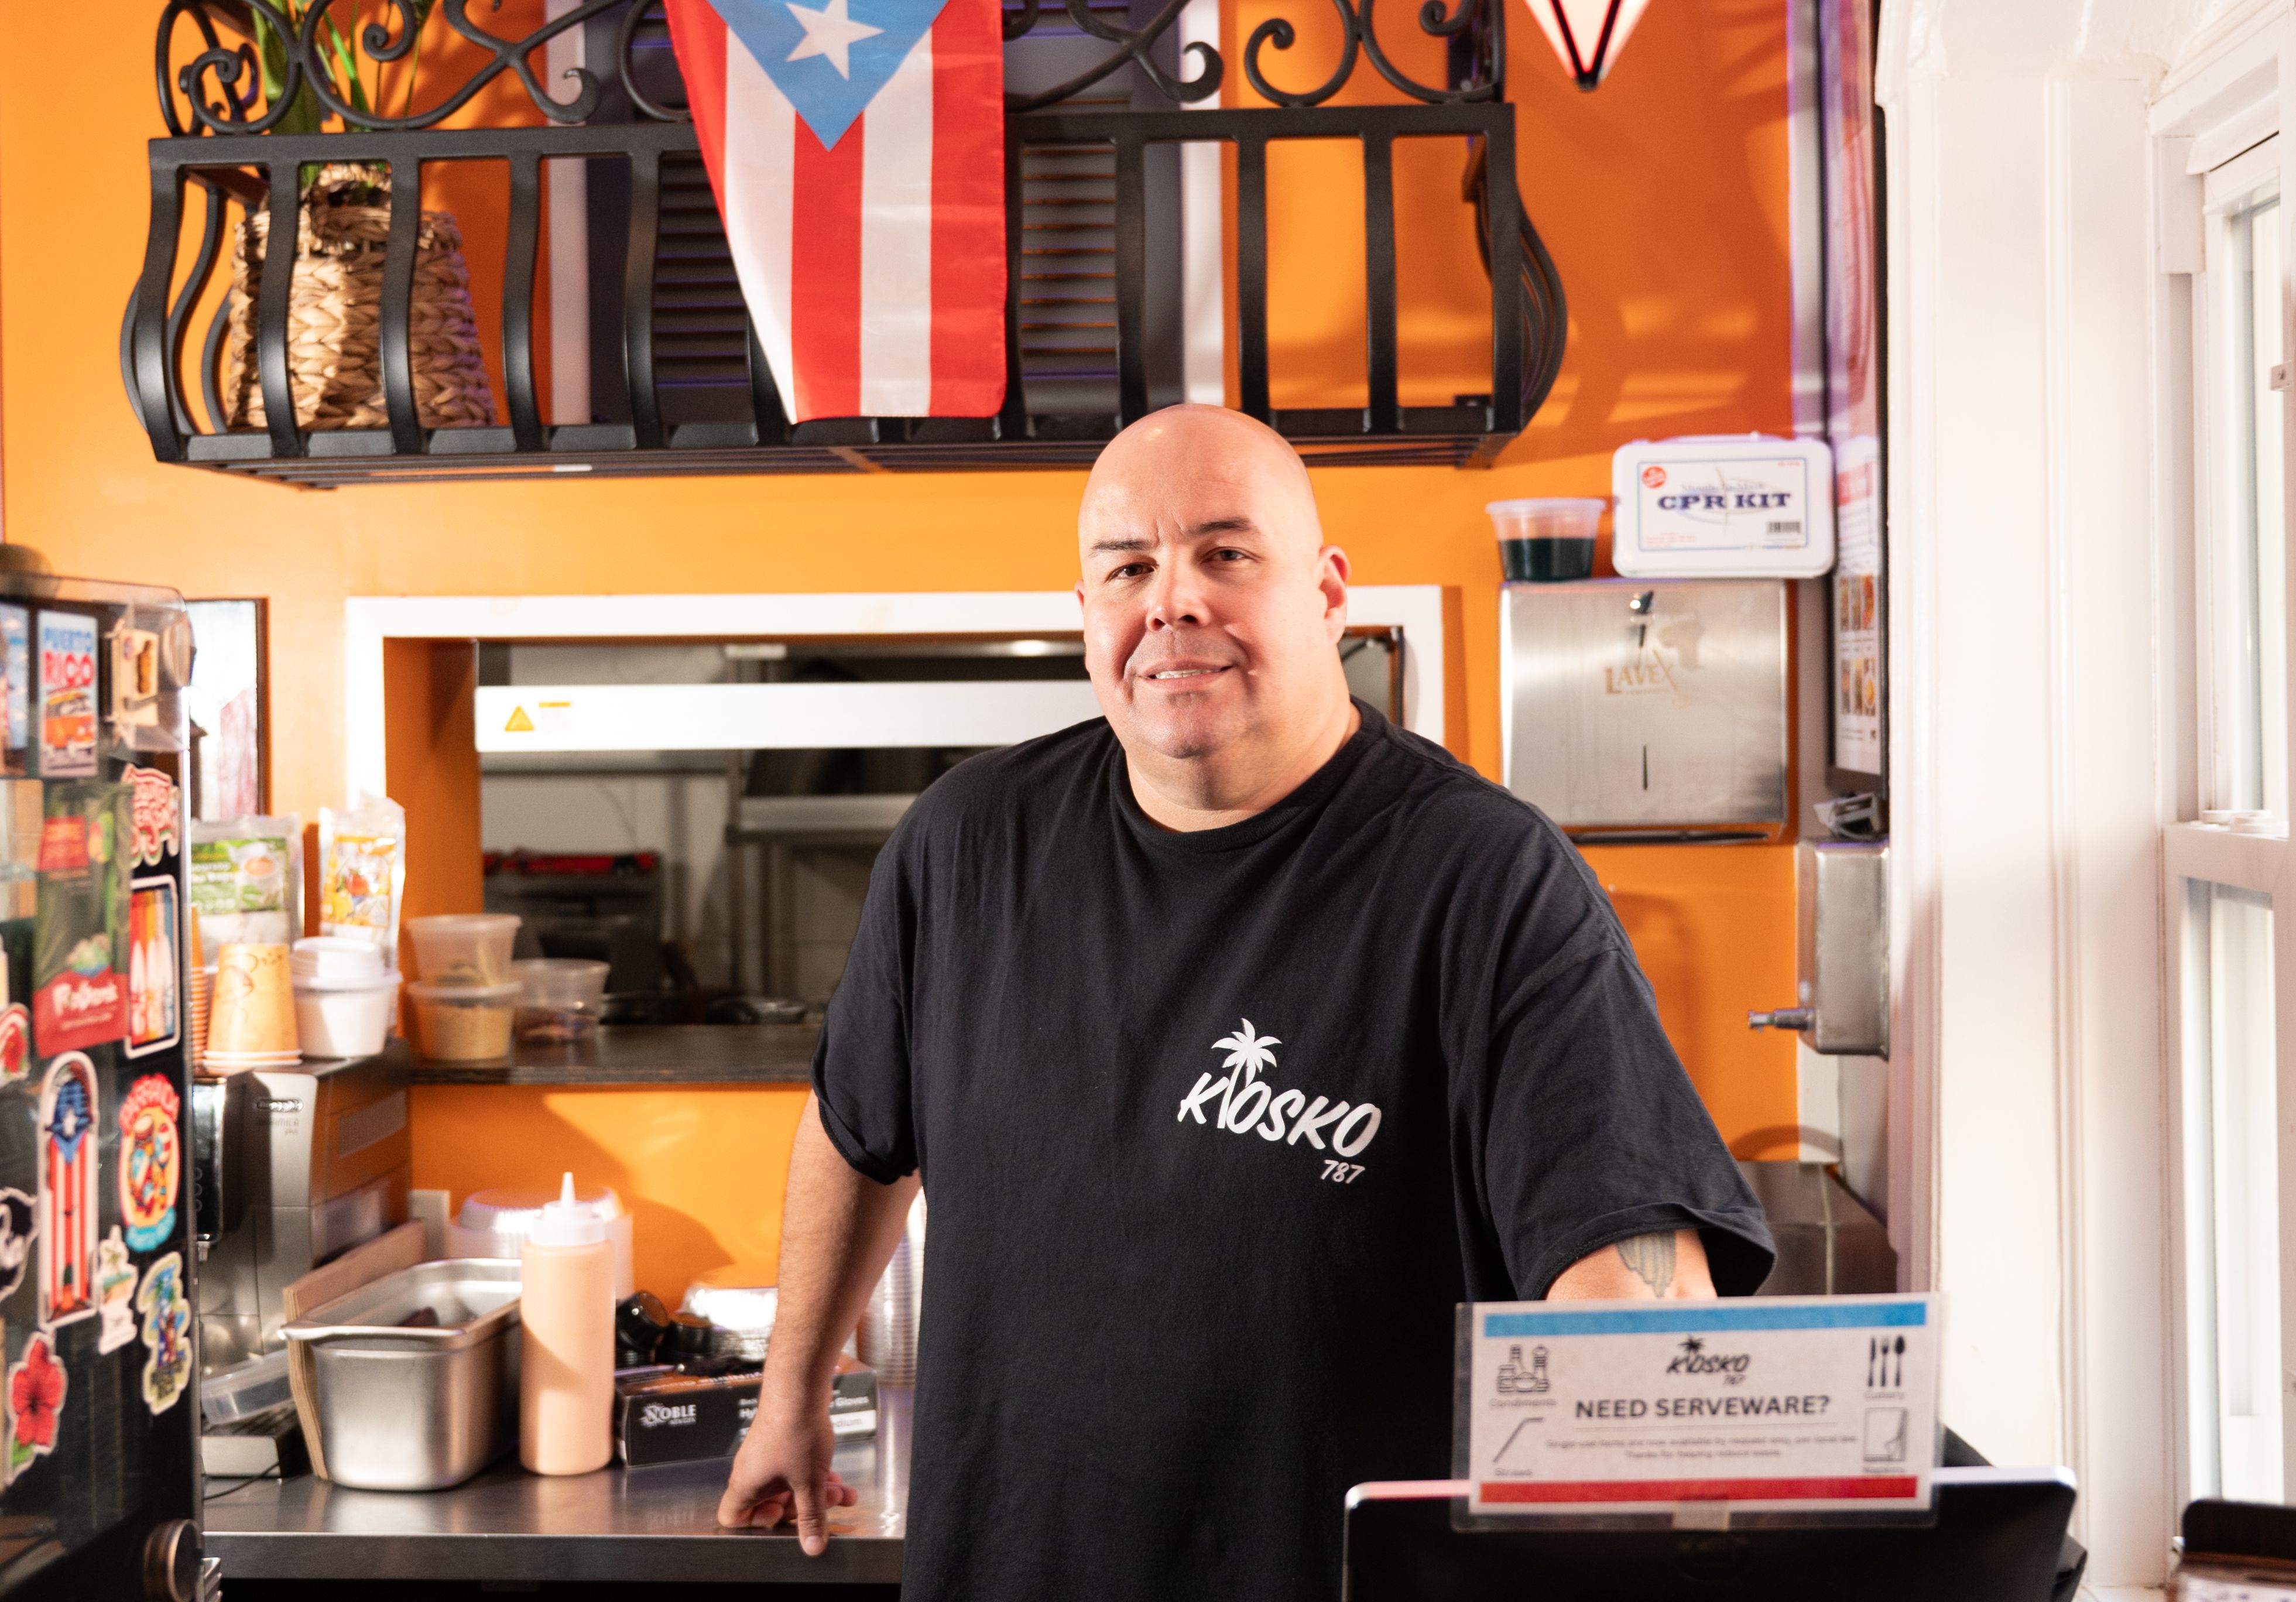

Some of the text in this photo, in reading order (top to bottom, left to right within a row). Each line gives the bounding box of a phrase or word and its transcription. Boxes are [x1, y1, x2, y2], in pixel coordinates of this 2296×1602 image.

[1658, 492, 1791, 510] CPR KIT
[44, 651, 95, 687] RICO
[1177, 1063, 1382, 1158] KIOSKO
[1321, 1159, 1366, 1184] 787
[1666, 1350, 1750, 1374] KIOSKO
[1575, 1395, 1831, 1418] NEED SERVEWARE?
